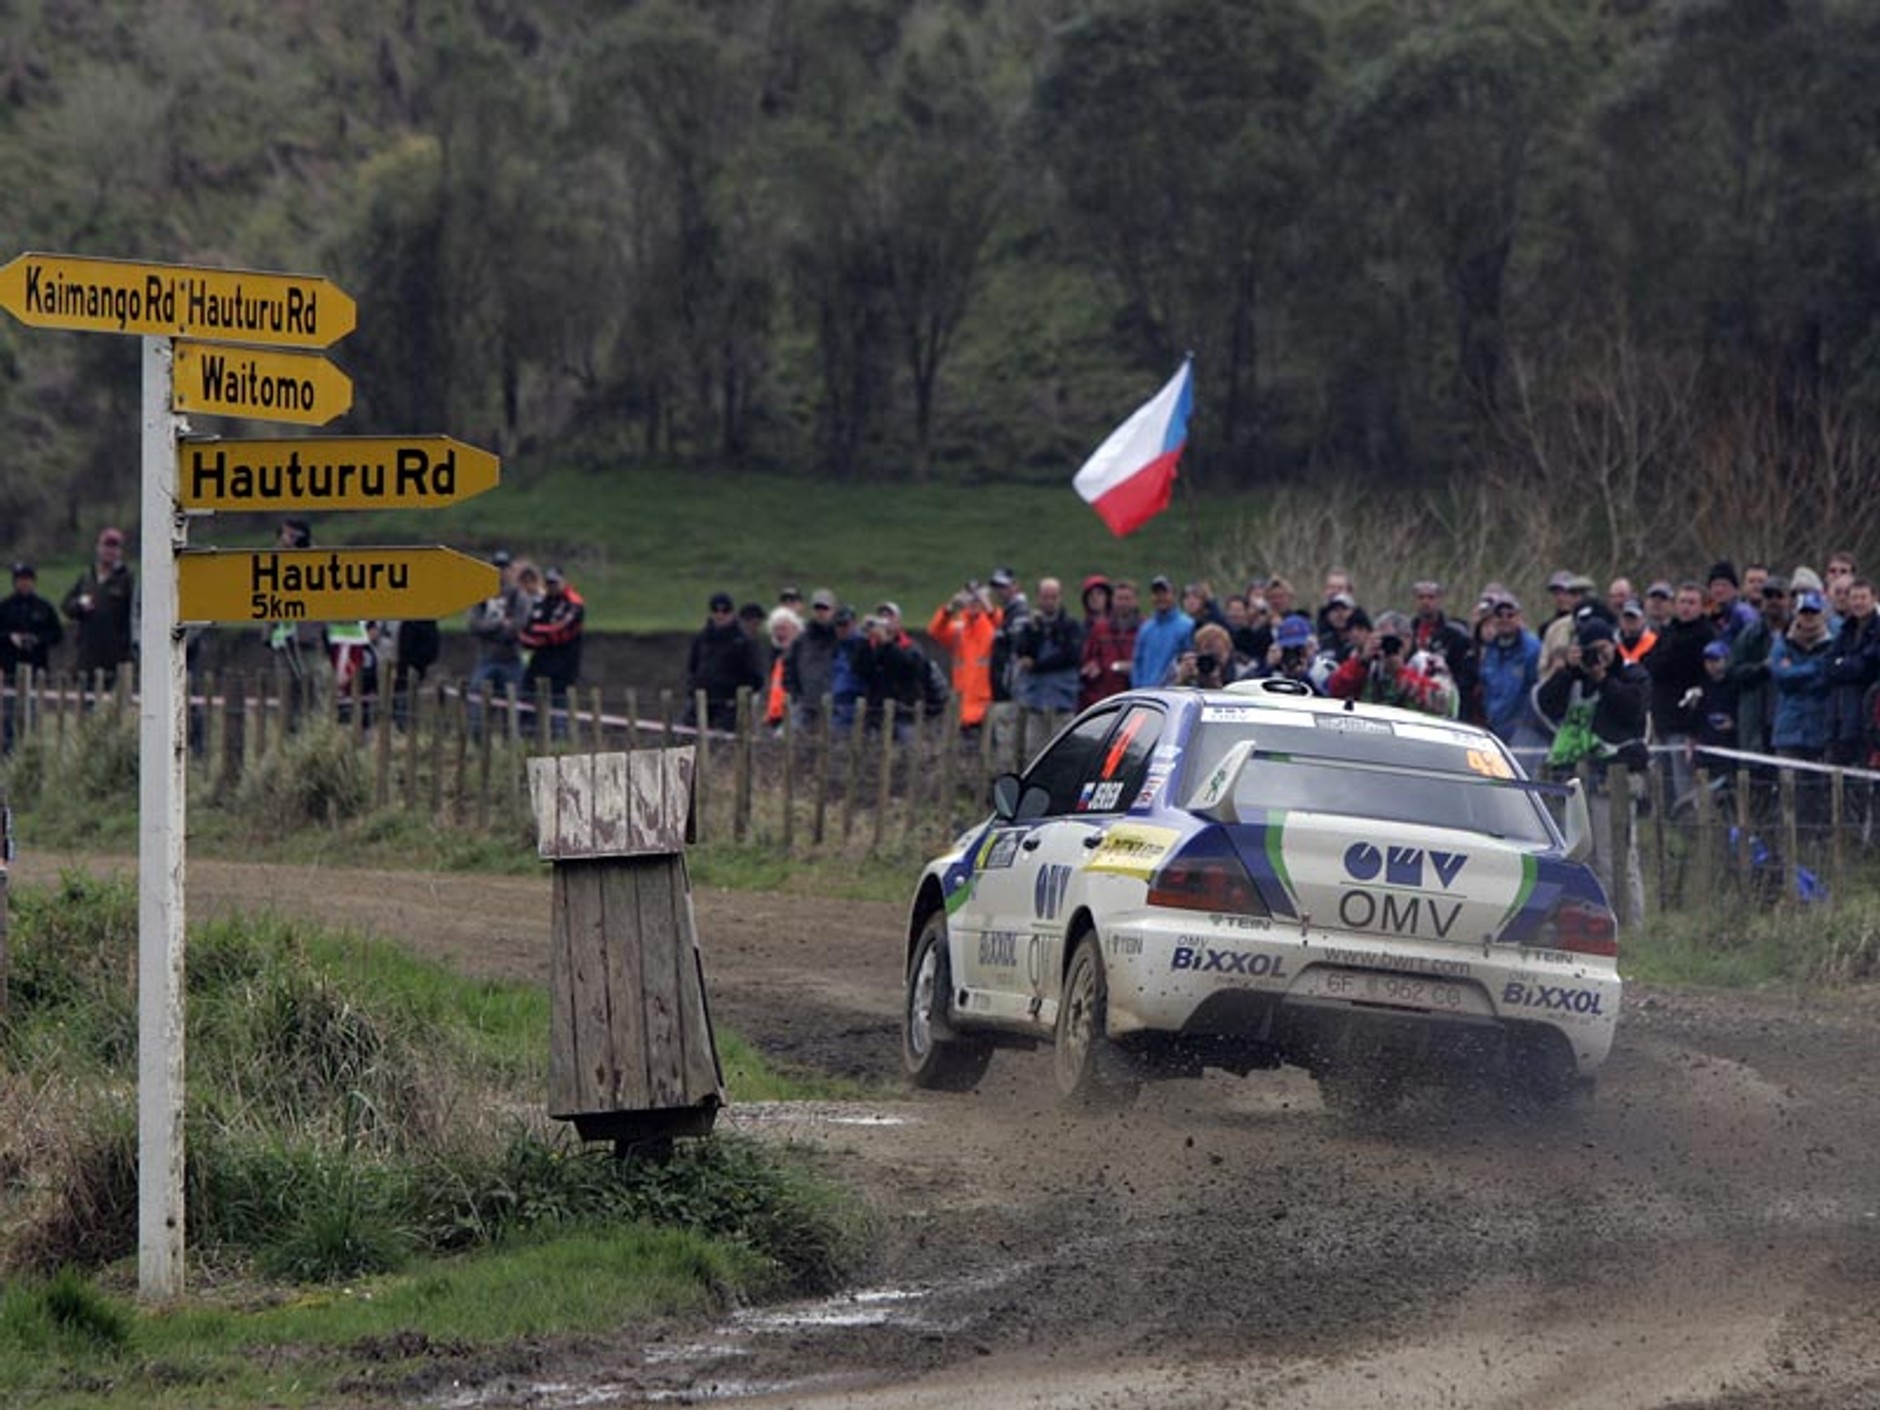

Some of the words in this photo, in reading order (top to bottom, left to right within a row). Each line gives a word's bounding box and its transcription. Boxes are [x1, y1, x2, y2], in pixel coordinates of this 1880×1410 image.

[26, 266, 140, 329] Kaimango
[146, 275, 175, 321] Rd
[188, 279, 282, 332] Hauturu
[287, 287, 316, 334] Rd
[202, 355, 314, 410] Waitomo
[192, 452, 384, 498] Hauturu
[396, 449, 456, 495] Rd
[252, 554, 408, 592] Hauturu
[252, 594, 305, 619] 5km
[1344, 841, 1469, 889] OMV
[1339, 889, 1463, 938] OMV
